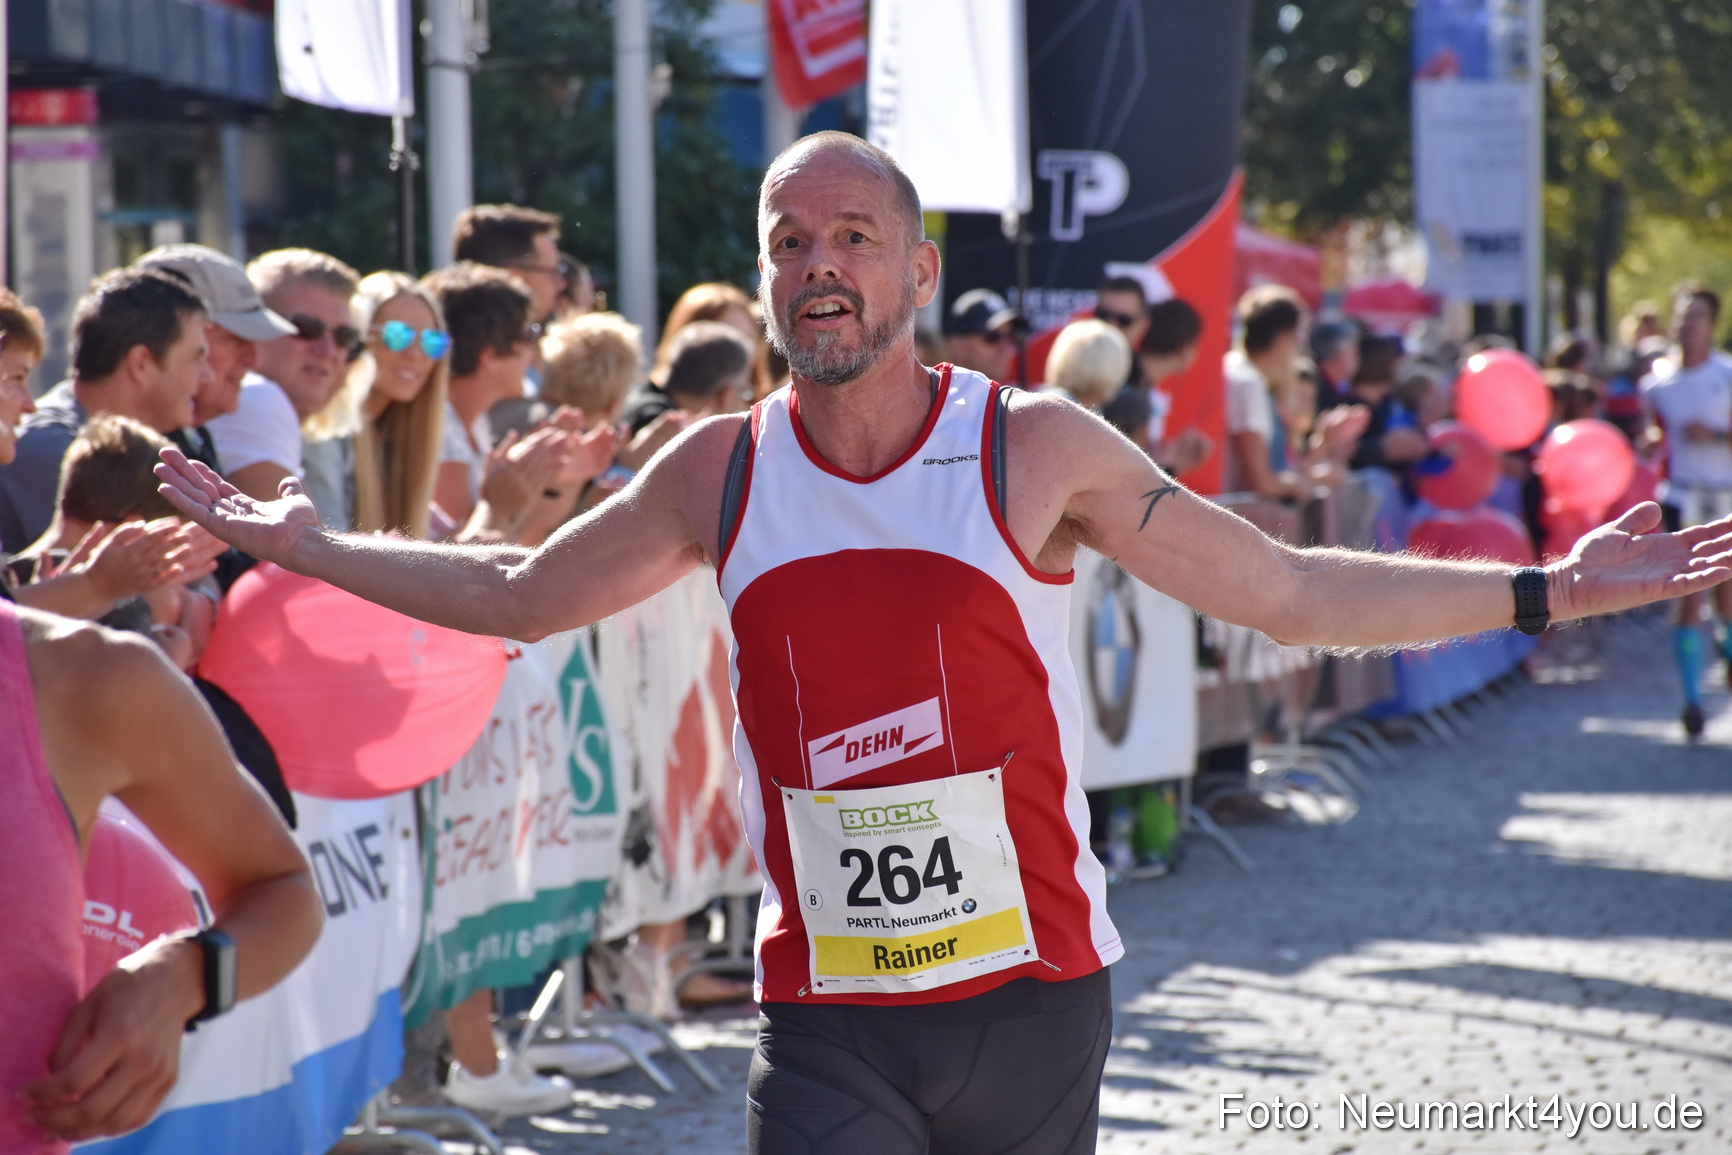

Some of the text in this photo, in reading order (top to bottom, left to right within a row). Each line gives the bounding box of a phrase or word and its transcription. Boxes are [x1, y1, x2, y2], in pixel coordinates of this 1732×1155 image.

[923, 454, 979, 465] BROOKS
[845, 725, 904, 764] DEHN
[839, 799, 940, 830] BOCK
[843, 830, 872, 839] inspired
[884, 827, 906, 835] smart
[908, 821, 942, 832] concepts
[840, 836, 963, 907] 264
[809, 895, 817, 906] B
[847, 906, 957, 929] PARTL Neumarkt
[873, 937, 958, 970] Rainer
